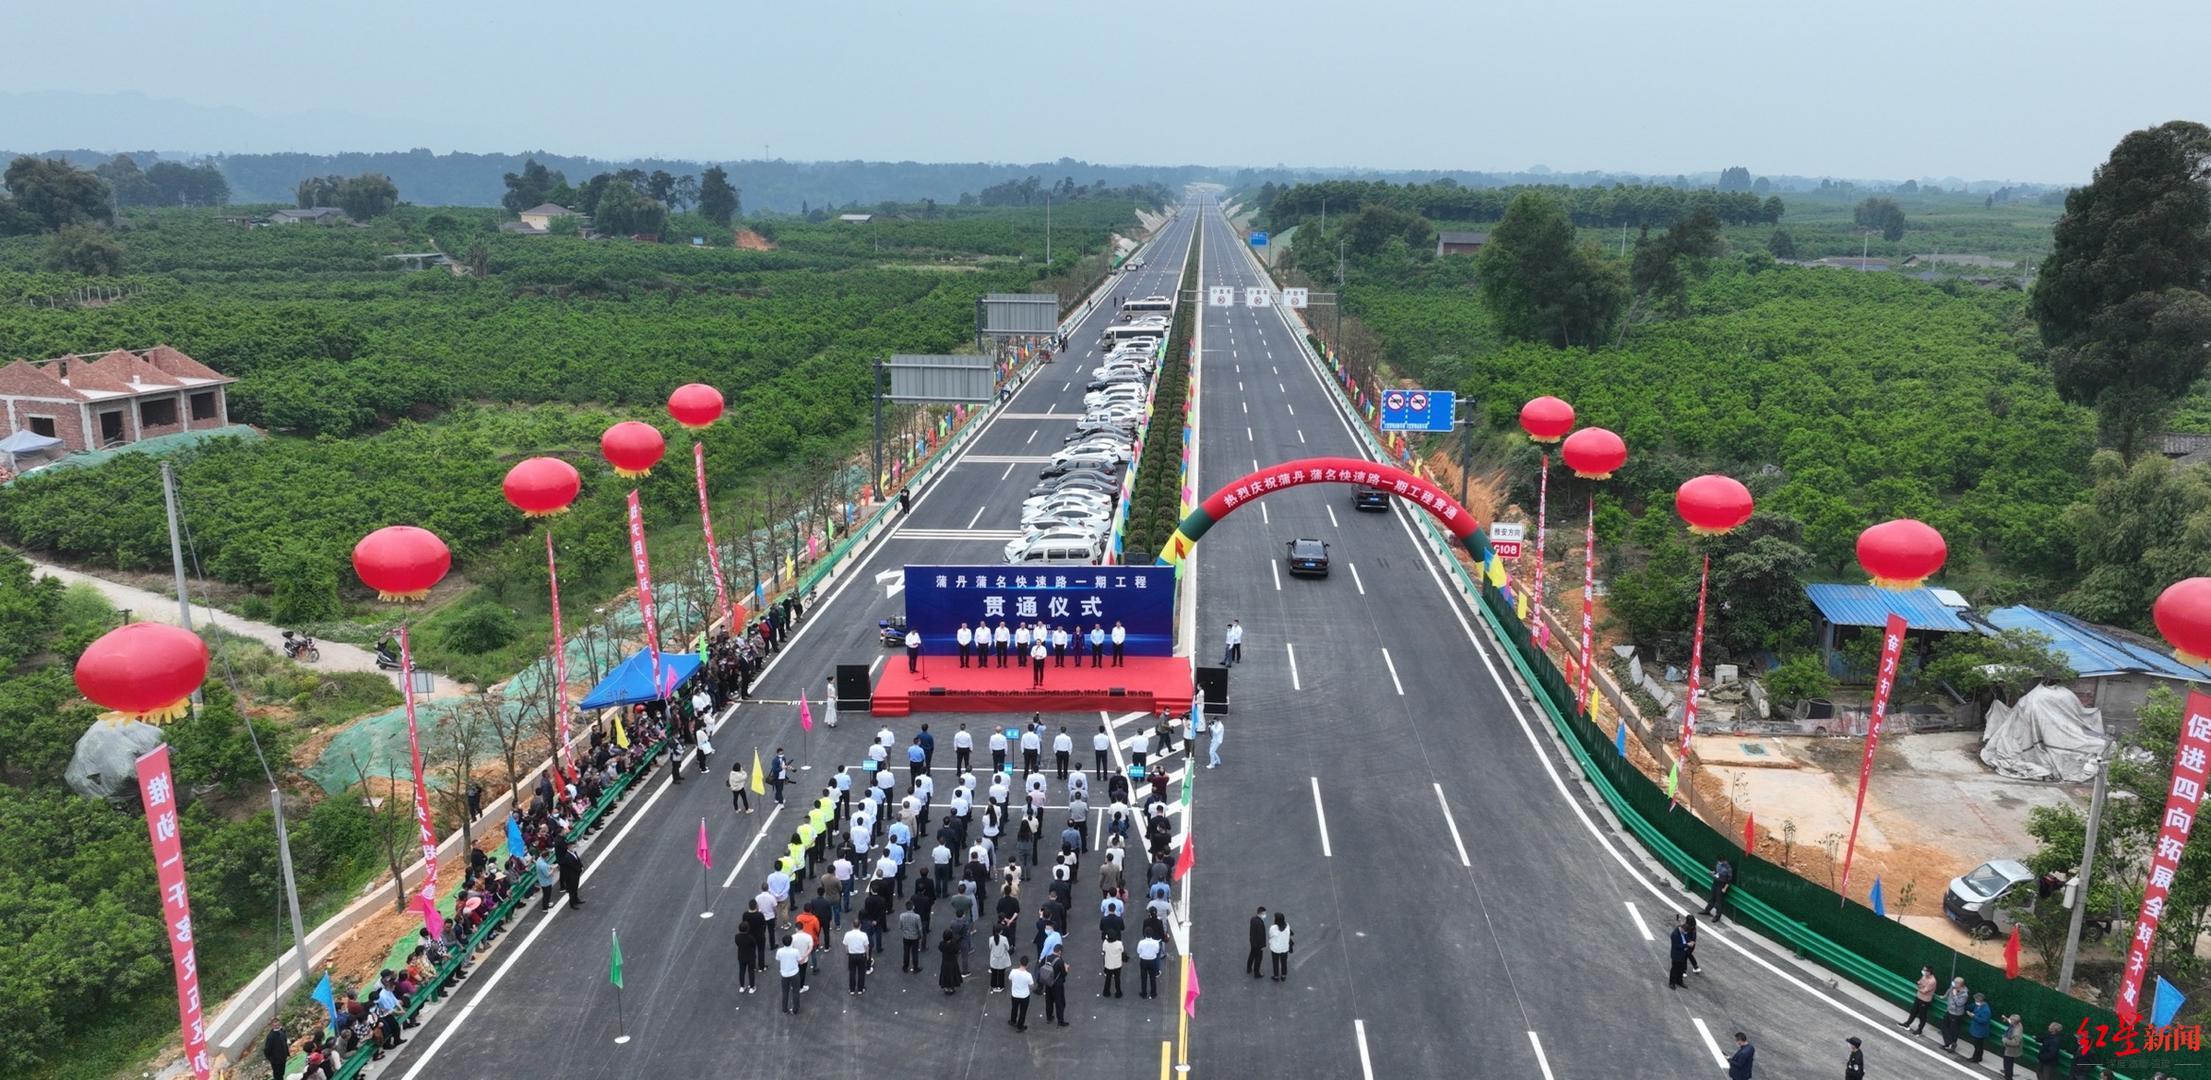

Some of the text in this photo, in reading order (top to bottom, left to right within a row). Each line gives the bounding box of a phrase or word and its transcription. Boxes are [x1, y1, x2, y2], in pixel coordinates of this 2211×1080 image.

[1224, 468, 1459, 520] 热烈庆祝蒲丹 蒲名快速路一期工程贯通
[1493, 544, 1518, 555] G108
[936, 575, 1148, 589] 蒲丹蒲名快速路一期工程
[983, 596, 1103, 618] 贯通仪式
